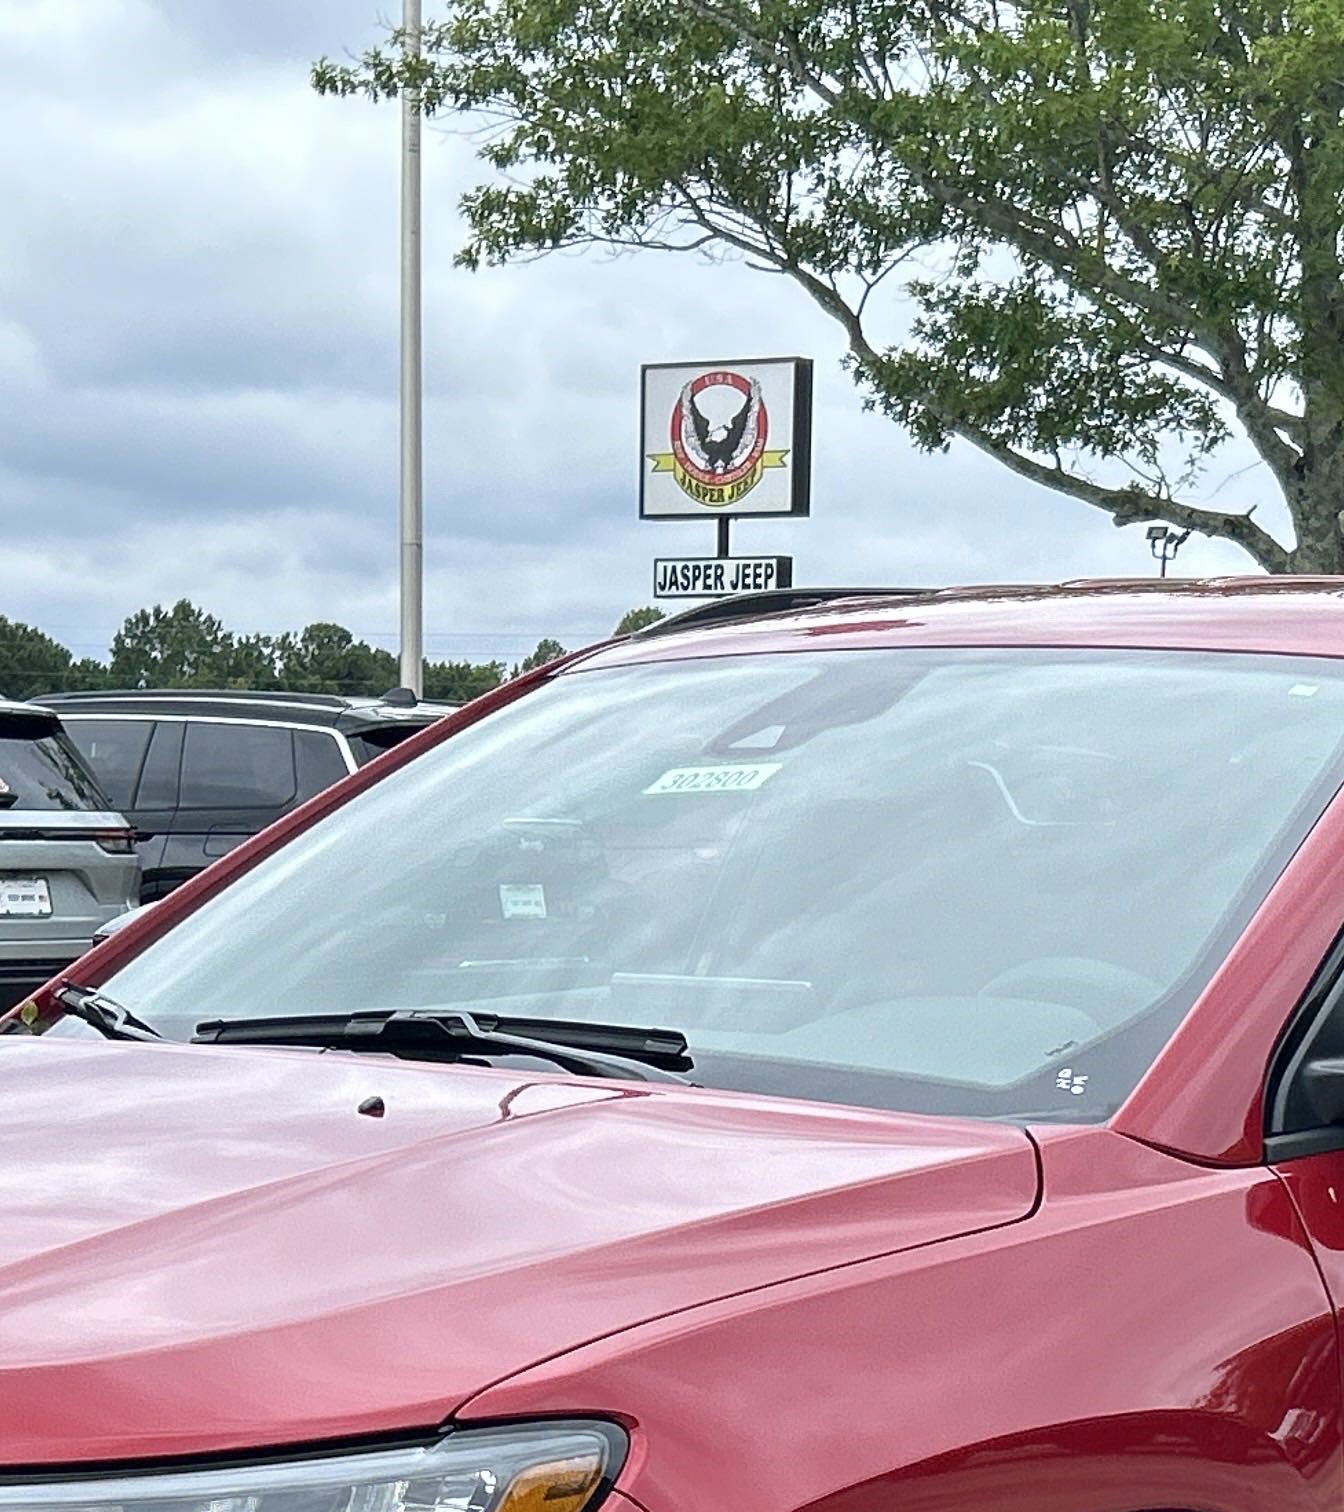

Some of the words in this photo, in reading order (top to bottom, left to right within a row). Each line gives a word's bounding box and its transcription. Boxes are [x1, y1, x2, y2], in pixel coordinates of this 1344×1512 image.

[679, 472, 725, 502] JASPER
[727, 470, 757, 500] JEEP
[658, 562, 725, 591] JASPER
[730, 562, 774, 590] JEEP
